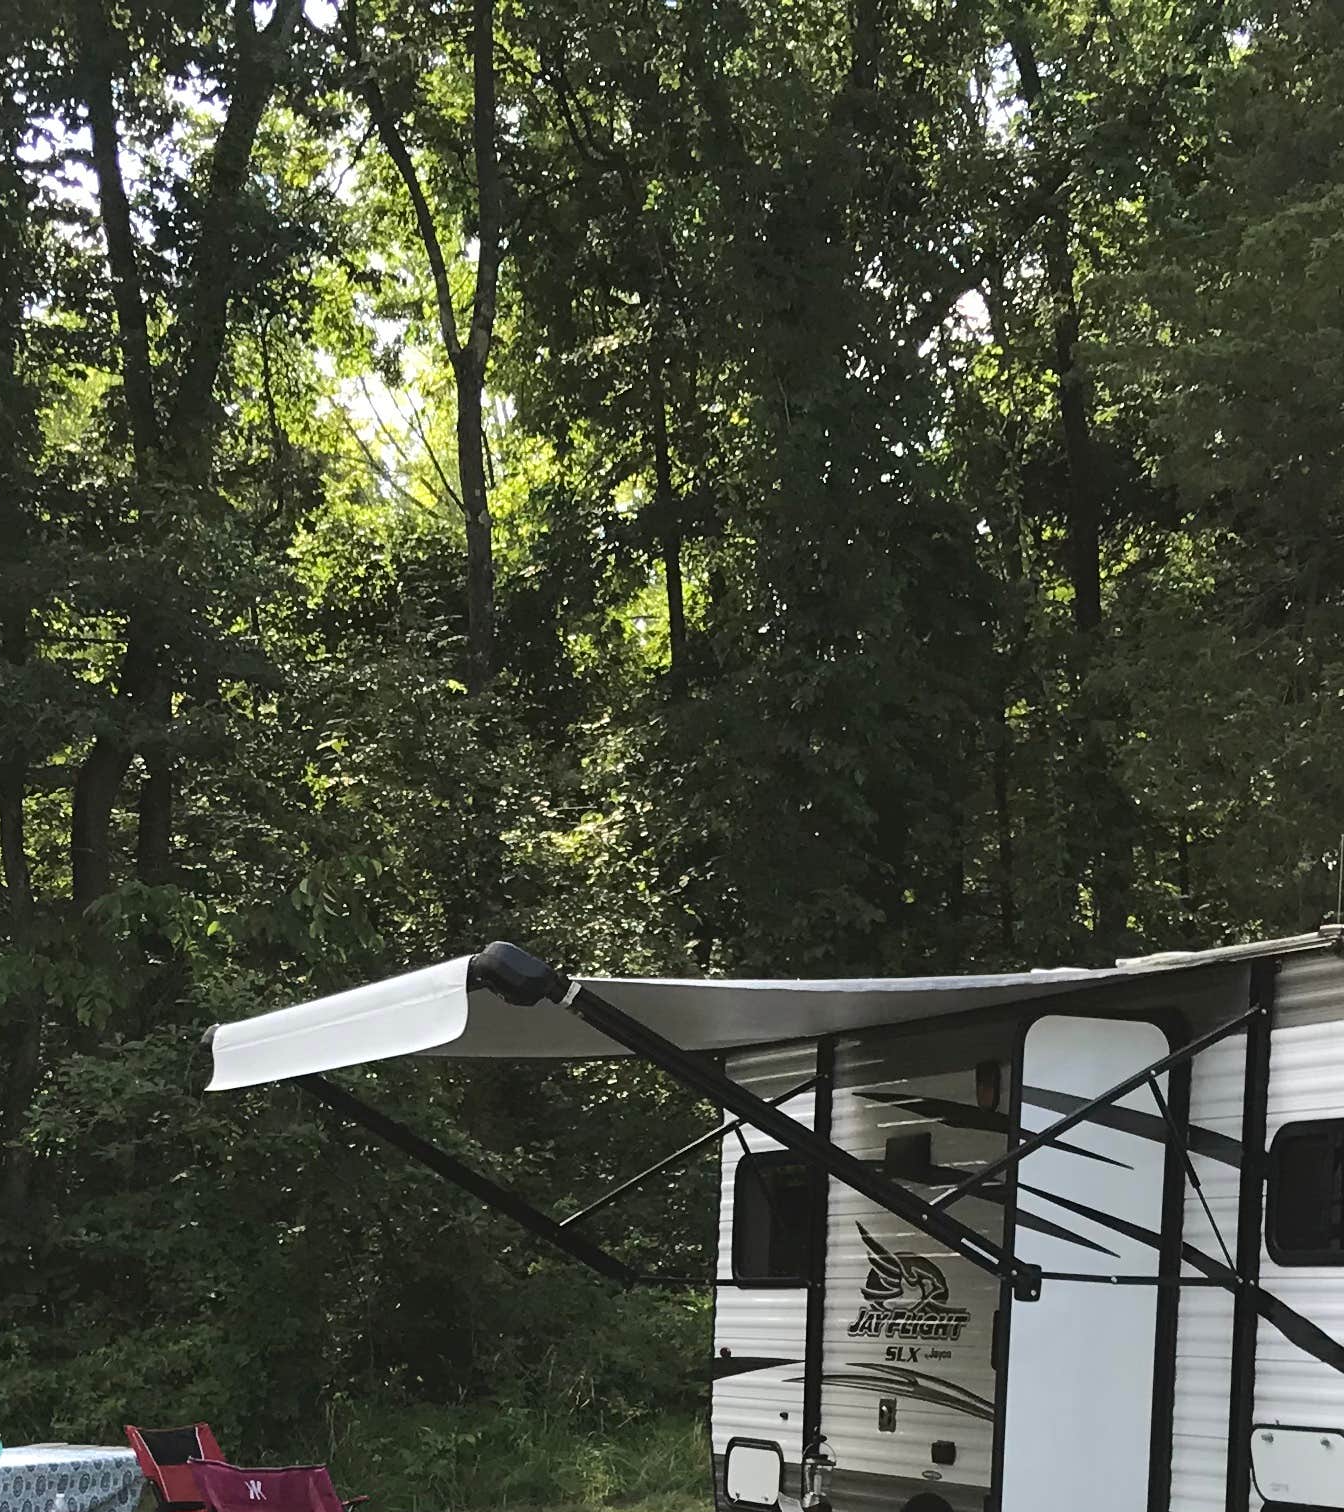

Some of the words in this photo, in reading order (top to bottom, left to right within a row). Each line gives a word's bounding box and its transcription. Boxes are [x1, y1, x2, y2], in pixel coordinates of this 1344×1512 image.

[848, 1307, 890, 1337] JAY
[885, 1308, 971, 1341] FLIGHT
[885, 1346, 920, 1362] SLX
